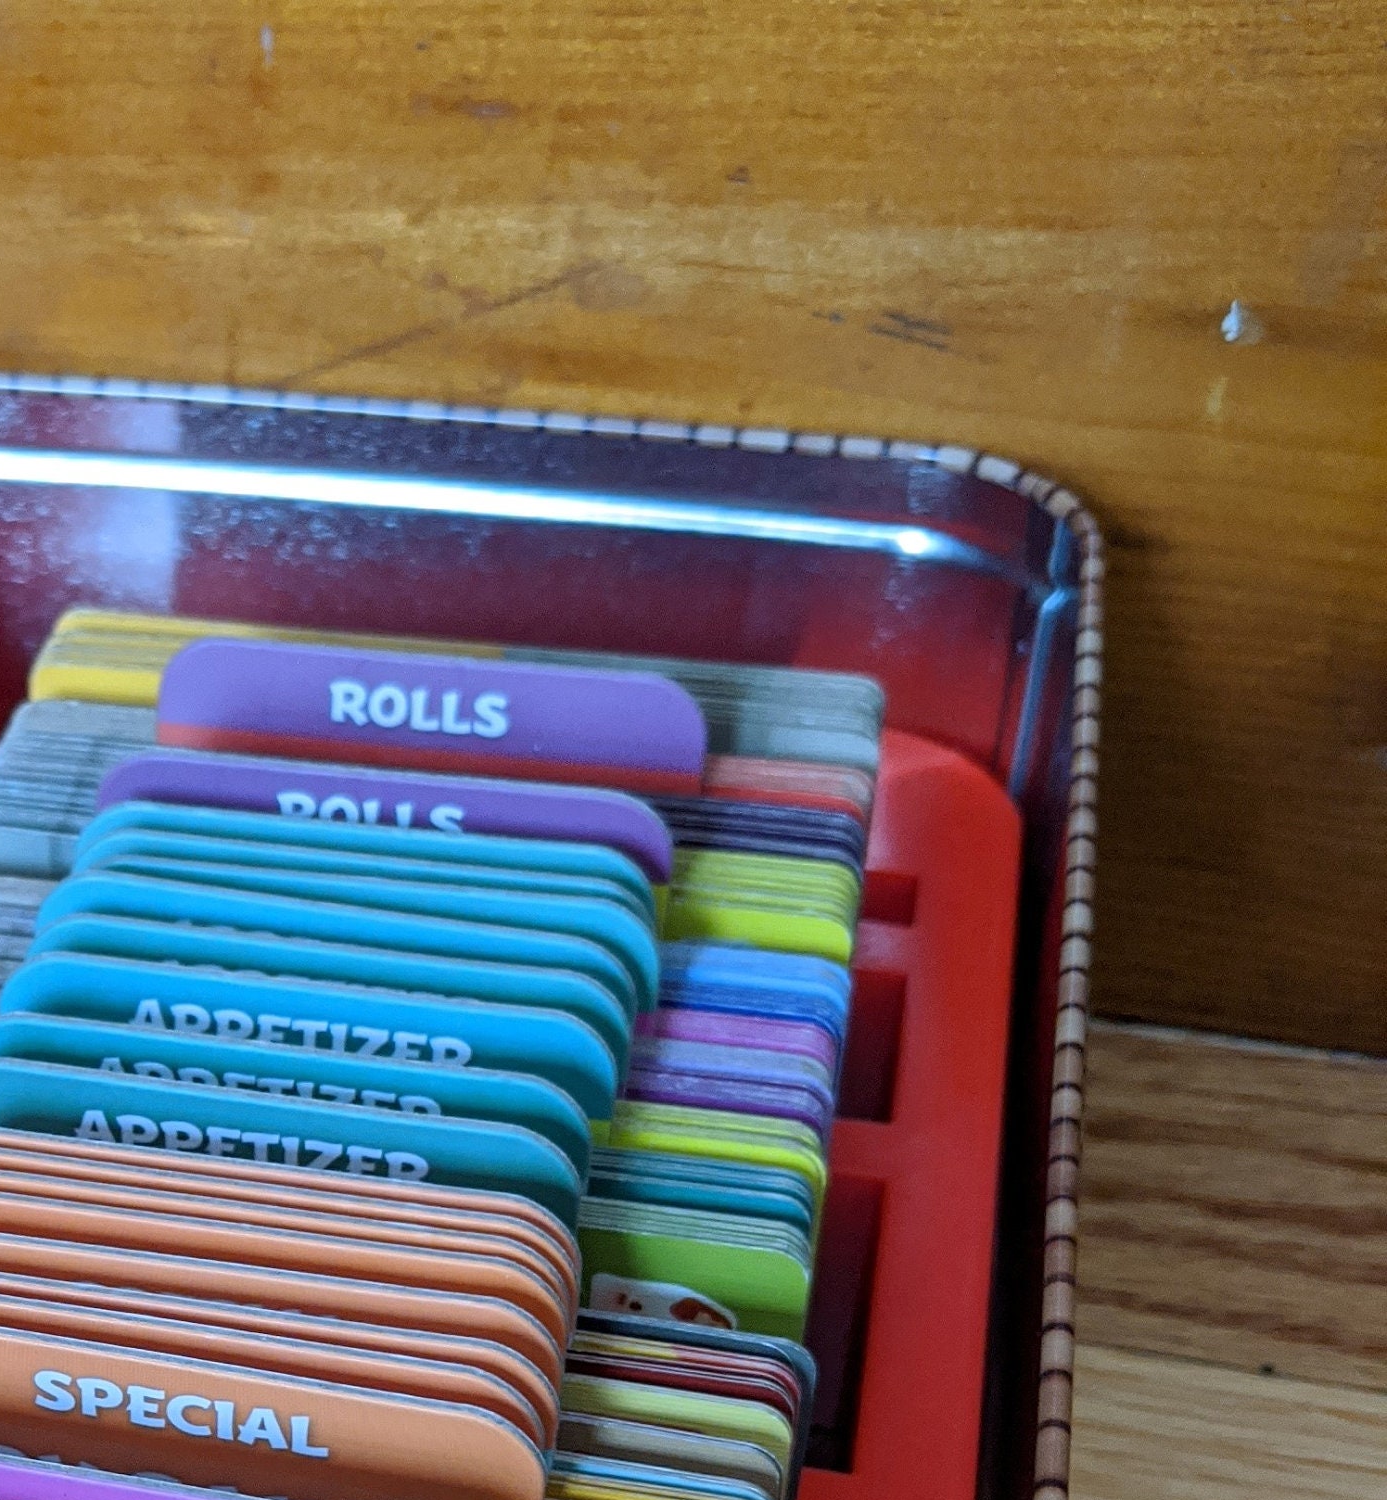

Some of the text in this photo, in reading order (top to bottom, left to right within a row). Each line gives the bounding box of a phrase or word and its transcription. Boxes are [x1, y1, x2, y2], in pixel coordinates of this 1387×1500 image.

[328, 678, 510, 739] ROLLS
[129, 998, 473, 1067] APPETIZER
[74, 1109, 430, 1183] APPETIZER
[33, 1369, 330, 1459] SPECIAL
